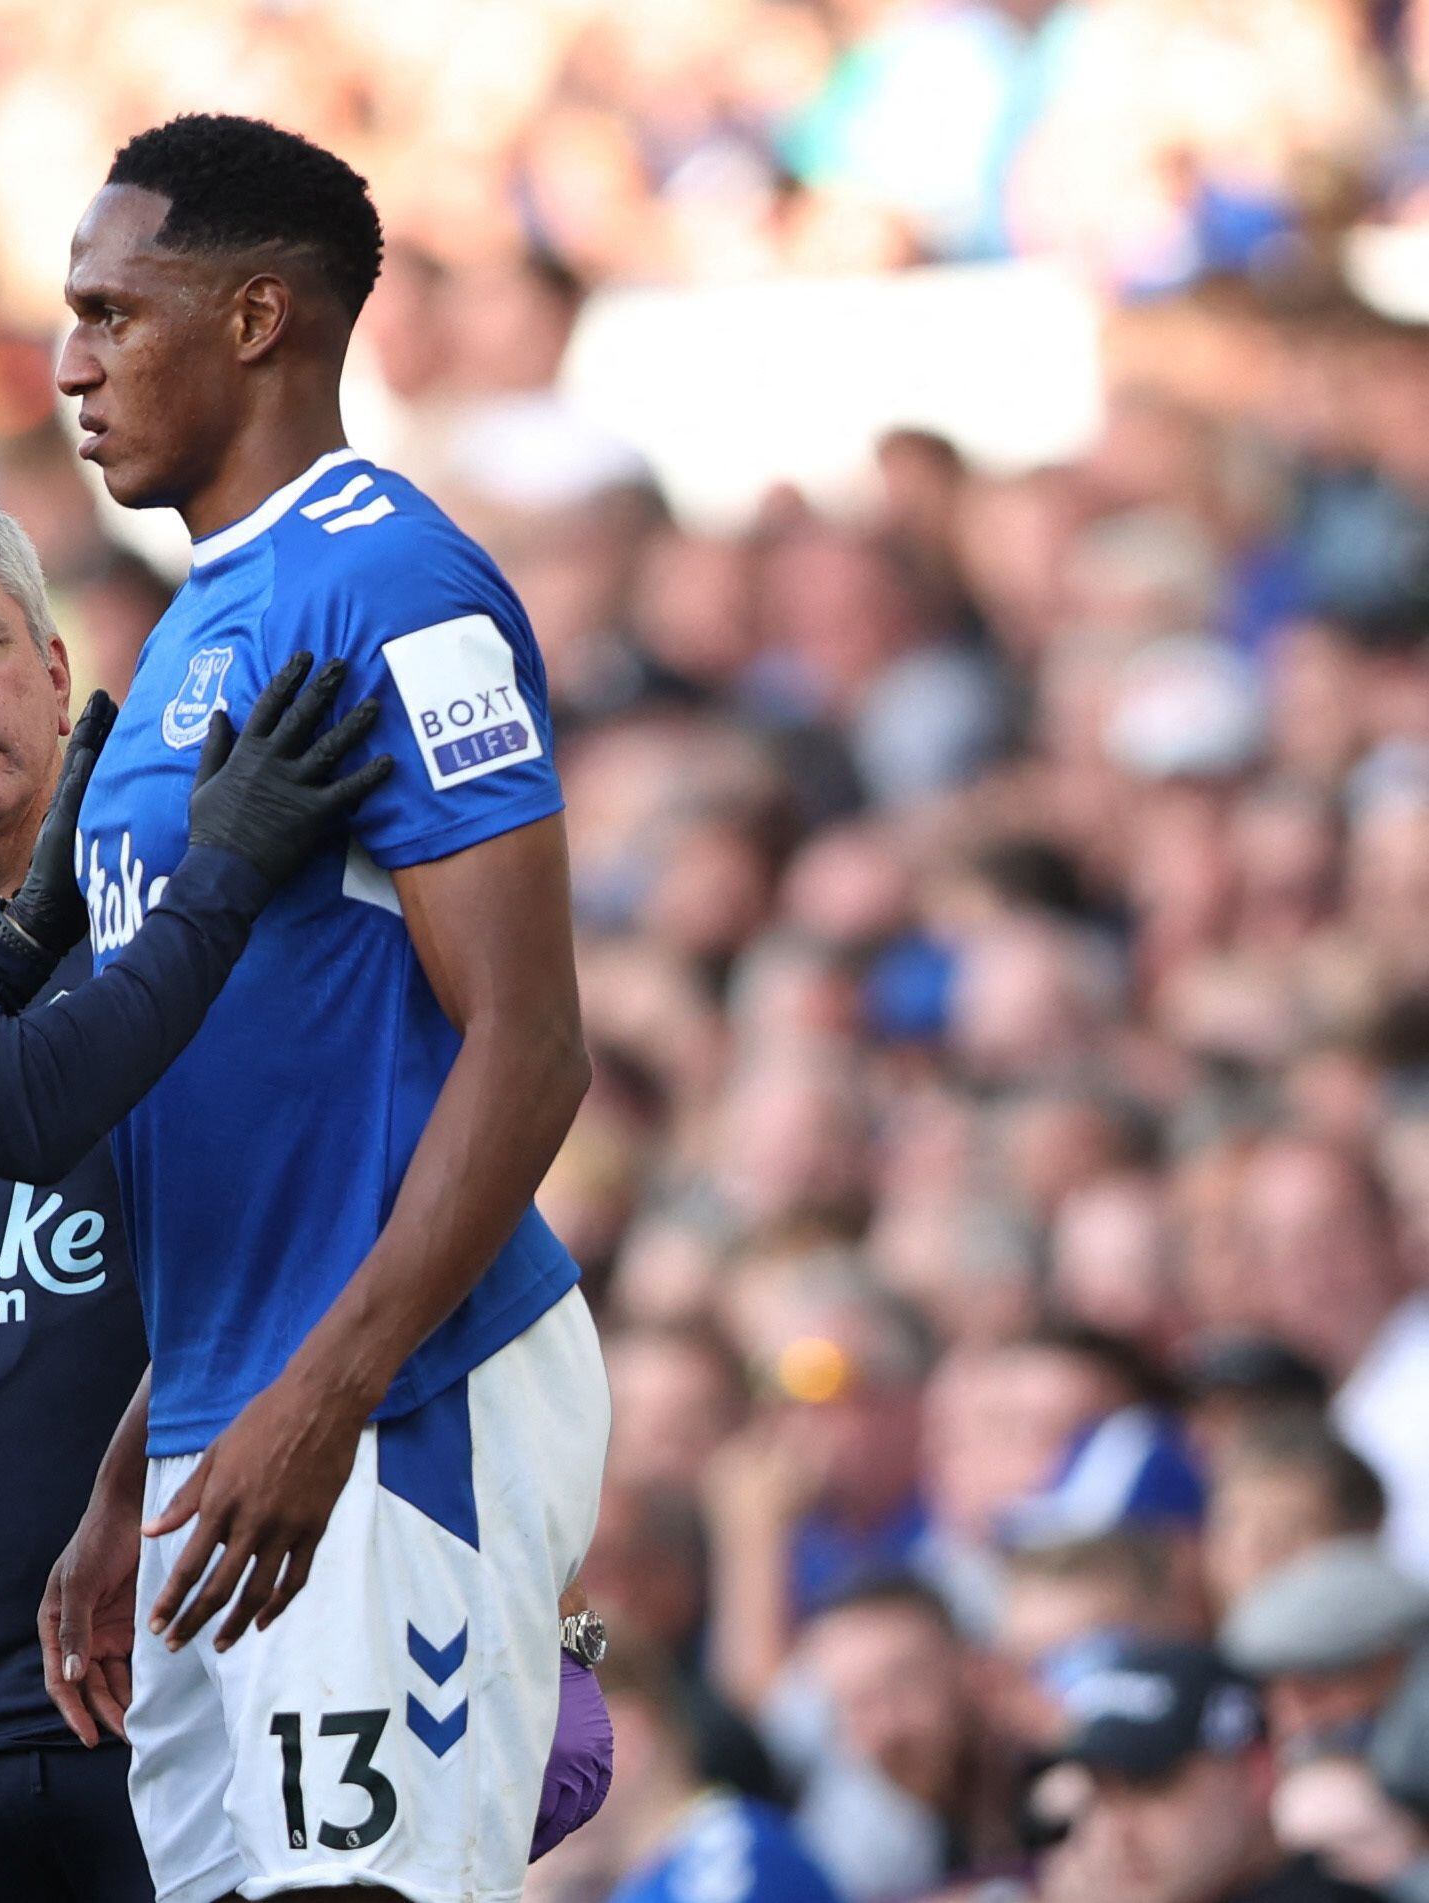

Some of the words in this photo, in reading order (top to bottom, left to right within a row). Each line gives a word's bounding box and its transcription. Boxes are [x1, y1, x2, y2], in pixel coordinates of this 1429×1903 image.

[420, 686, 513, 738] BOXT
[450, 726, 518, 758] LIFE
[269, 1708, 397, 1850] 13
